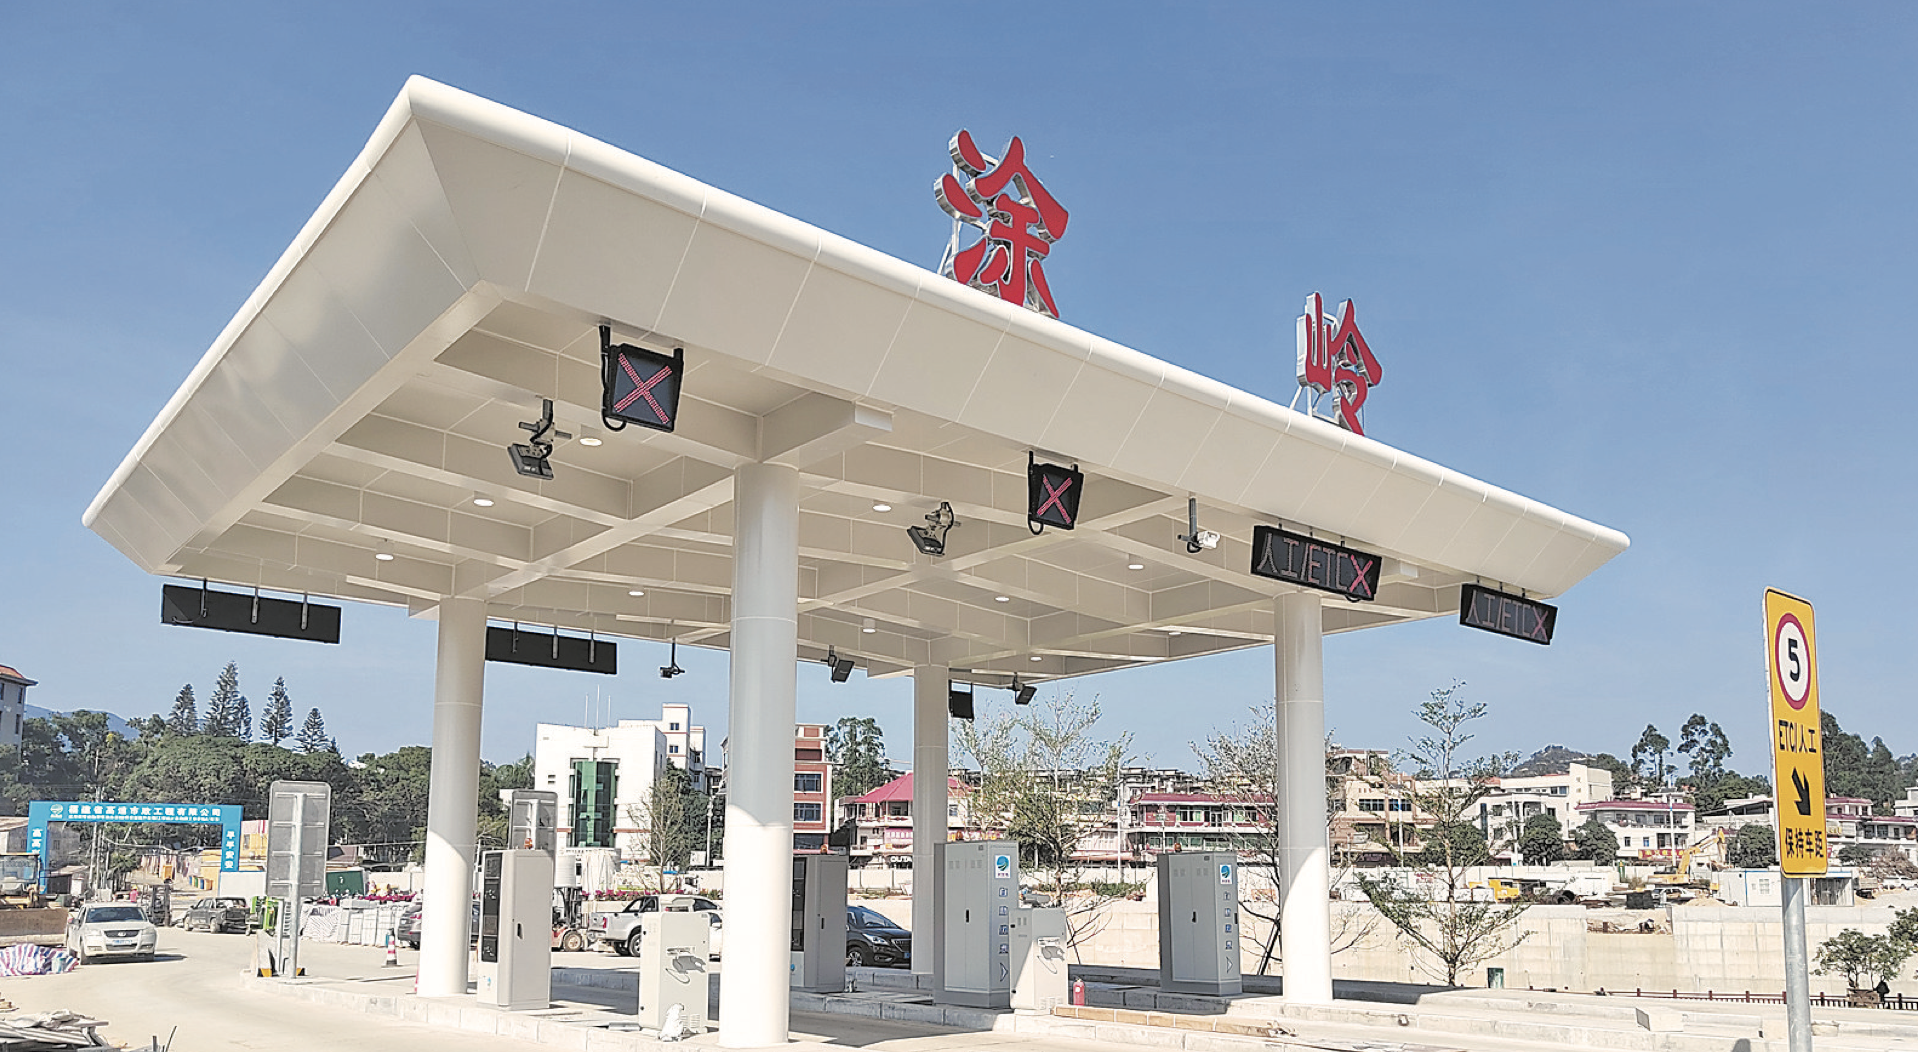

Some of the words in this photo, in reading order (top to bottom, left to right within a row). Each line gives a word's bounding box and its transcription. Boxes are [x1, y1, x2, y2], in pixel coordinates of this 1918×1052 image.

[1787, 638, 1800, 682] 5
[1778, 719, 1817, 754] ETC/人工
[1784, 827, 1824, 859] 保持车距
